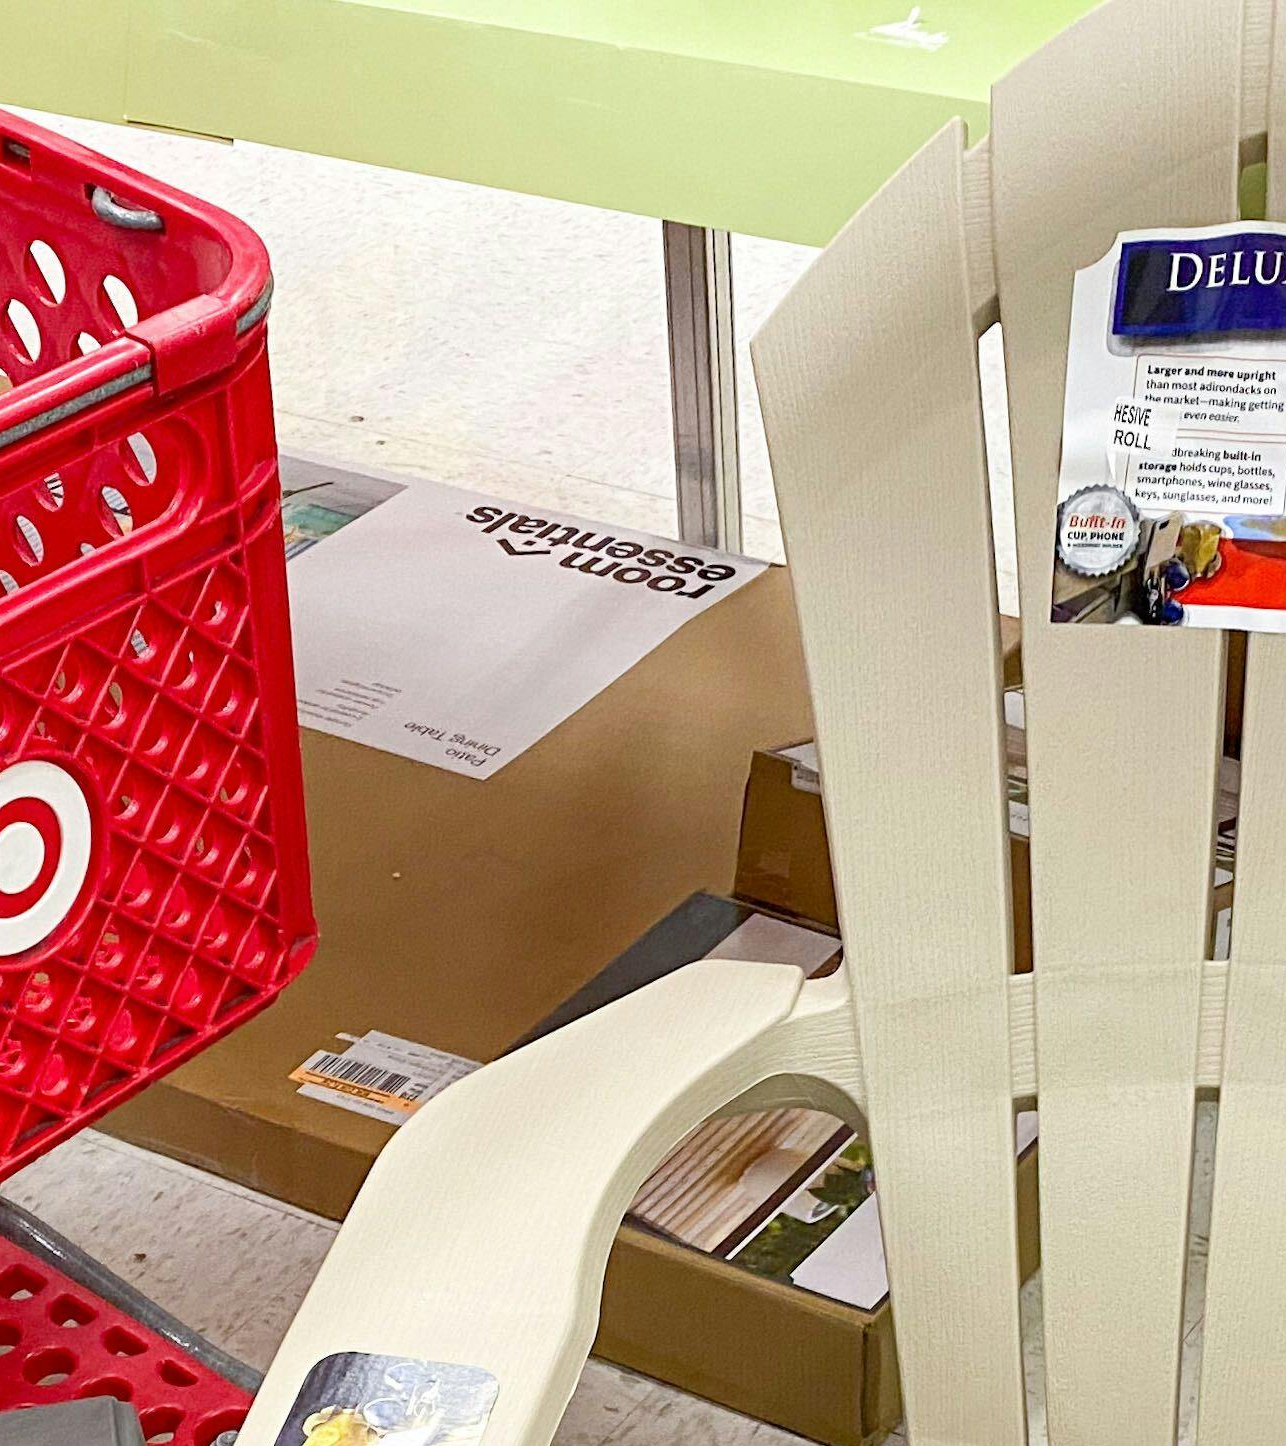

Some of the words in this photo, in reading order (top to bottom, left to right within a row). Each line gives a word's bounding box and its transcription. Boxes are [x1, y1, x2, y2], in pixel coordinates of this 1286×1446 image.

[1147, 364, 1183, 377] Larger
[1185, 366, 1204, 376] and
[1207, 369, 1234, 379] more
[1237, 369, 1277, 382] upright
[1146, 380, 1170, 391] than
[1172, 381, 1197, 391] most
[1200, 381, 1262, 395] adirondacks
[1264, 386, 1277, 395] on
[1248, 398, 1285, 413] getting
[1184, 412, 1207, 421] even
[1113, 429, 1152, 450] ROLL
[1138, 462, 1177, 473] storage
[1179, 462, 1207, 473] holds
[1209, 465, 1235, 477] cups,
[1237, 465, 1275, 478] bottles,
[1137, 475, 1205, 489] smartphones,
[1207, 478, 1232, 489] wine
[1233, 479, 1273, 492] glasses,
[1135, 489, 1160, 501] keys,
[1163, 491, 1219, 504] sunglasses,
[1221, 493, 1241, 504] and
[465, 505, 737, 582] essentials
[1090, 531, 1125, 541] PHONE
[559, 551, 715, 599] room
[404, 721, 448, 743] Table
[448, 732, 502, 757] Dining
[445, 747, 487, 767] Patio
